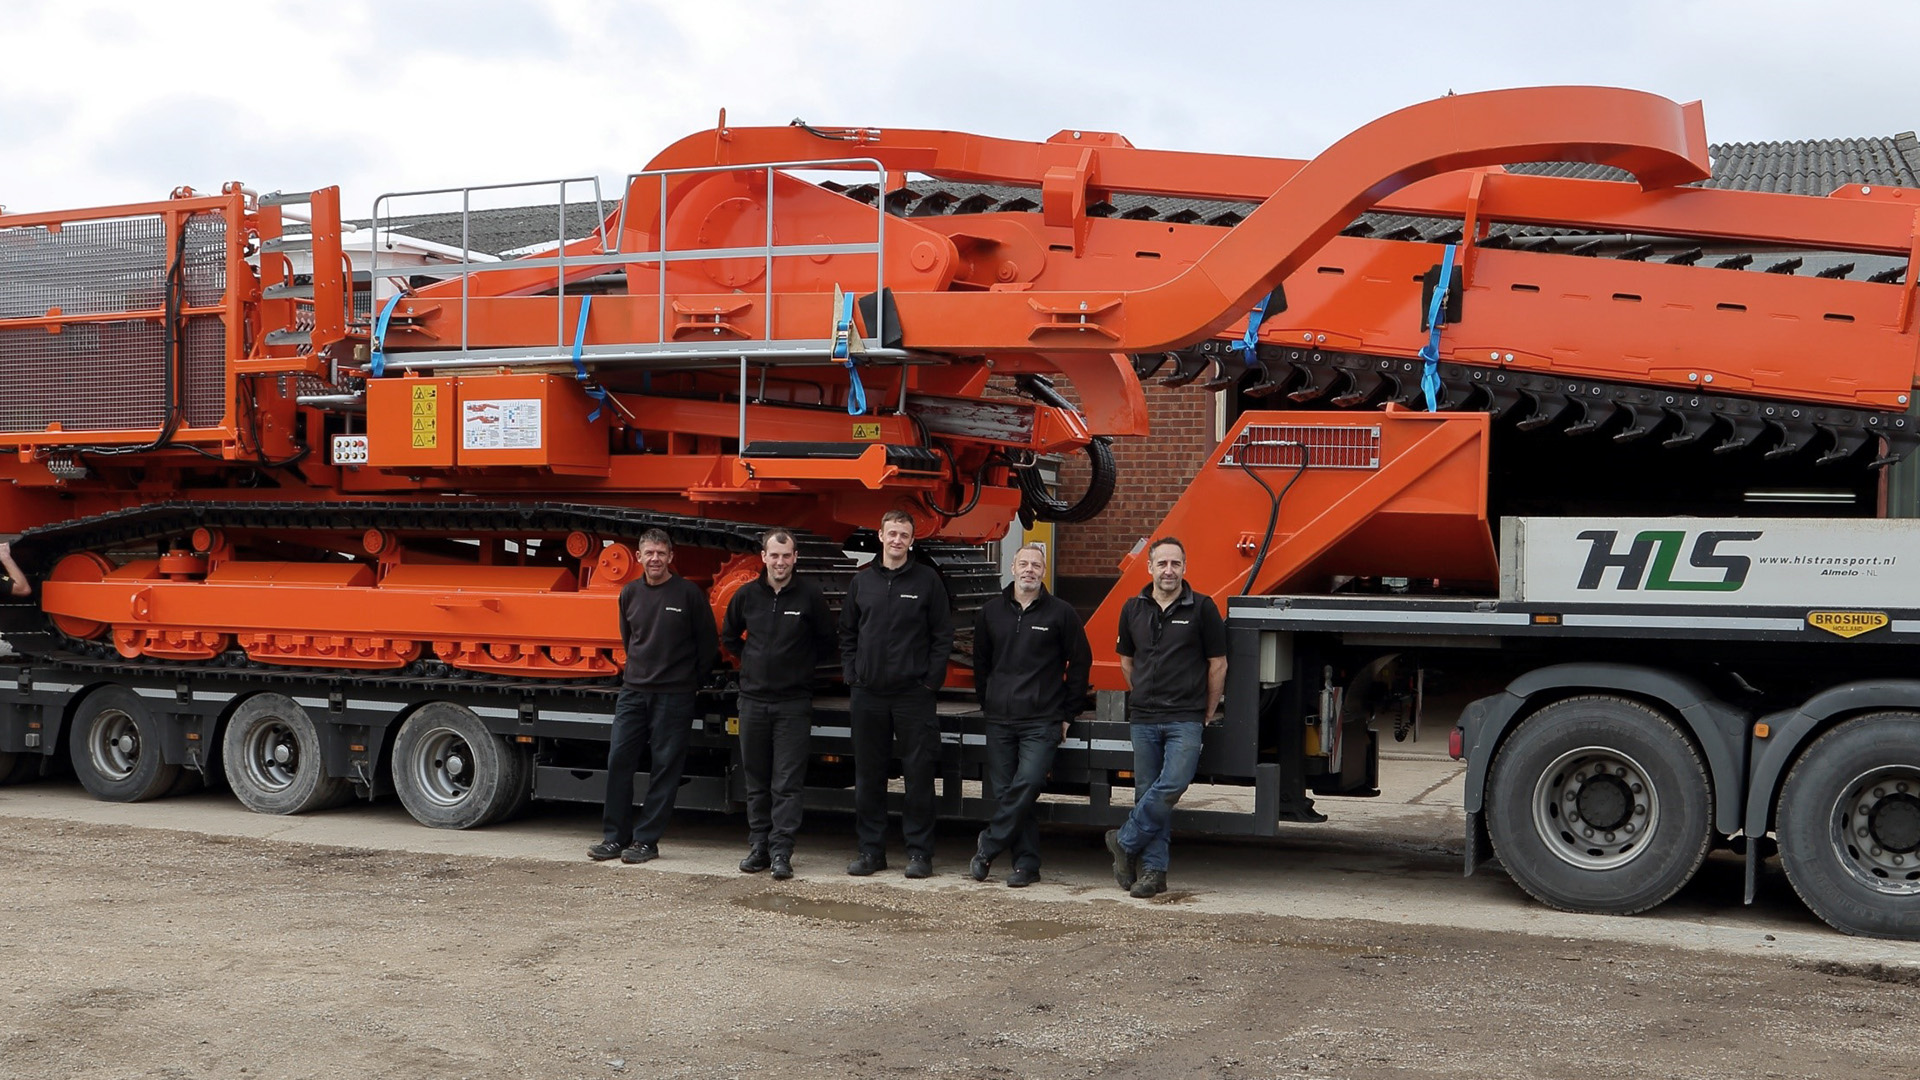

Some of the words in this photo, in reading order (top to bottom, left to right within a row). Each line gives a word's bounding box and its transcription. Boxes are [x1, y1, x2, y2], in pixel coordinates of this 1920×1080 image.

[1576, 530, 1764, 591] HLS
[1759, 556, 1896, 566] www.hlstransport.nl
[1815, 614, 1883, 625] BROSHUIS
